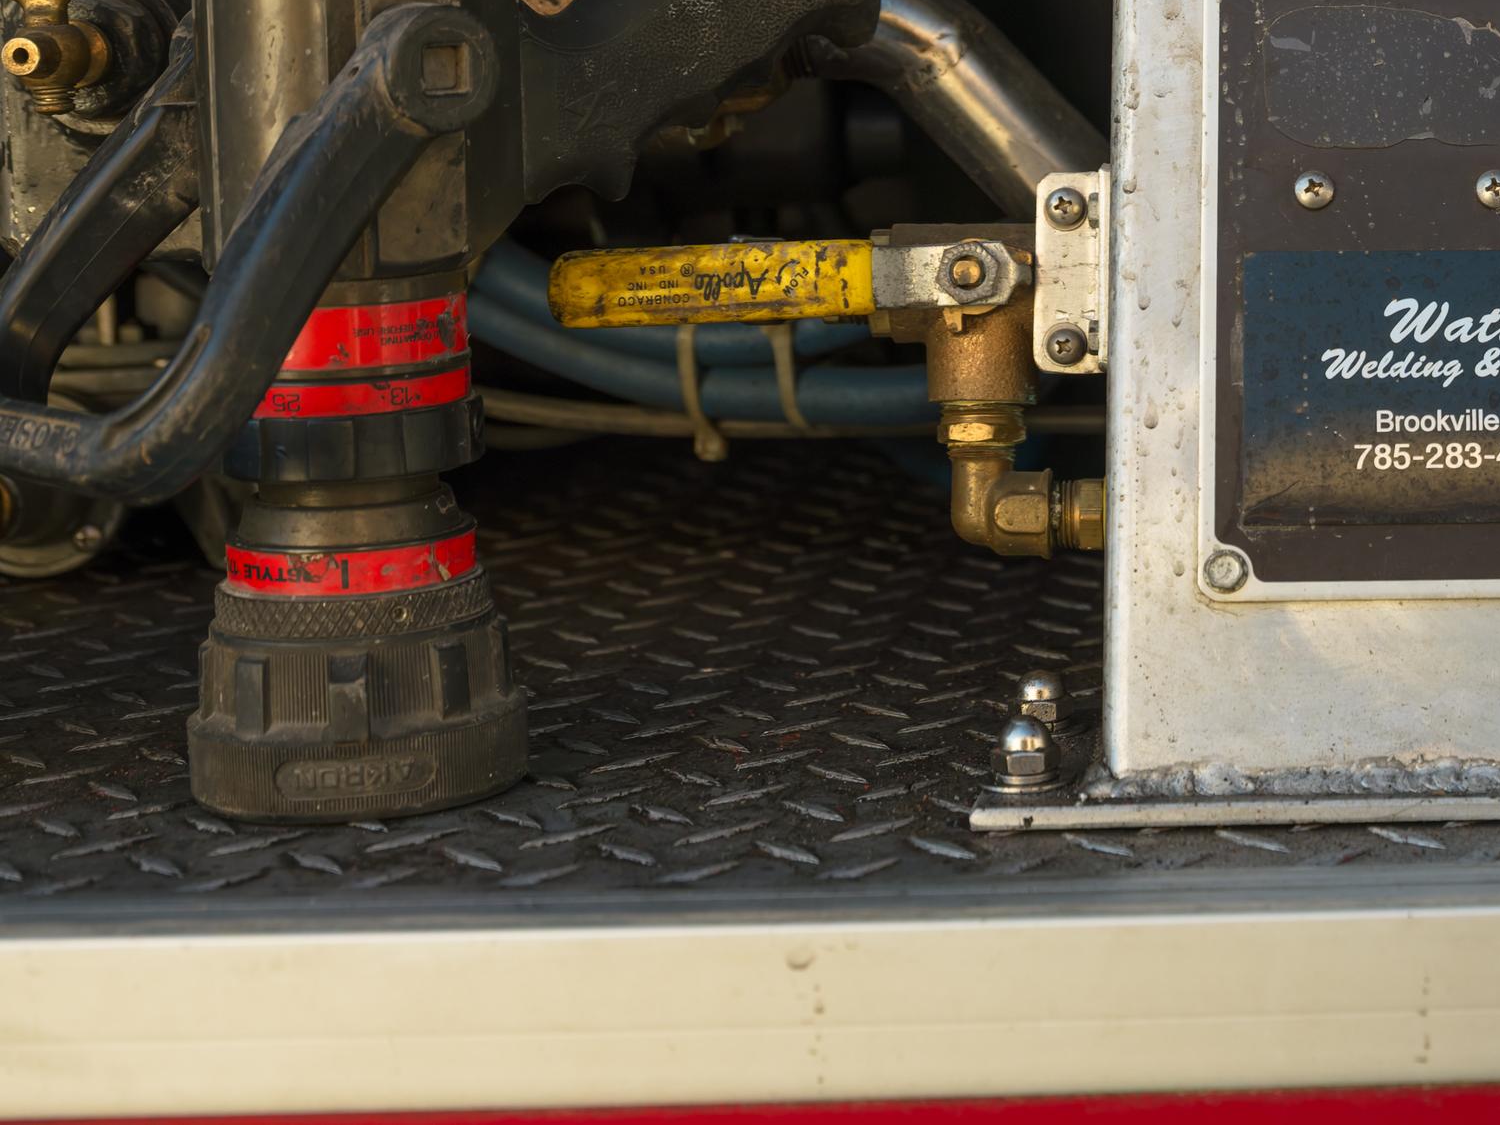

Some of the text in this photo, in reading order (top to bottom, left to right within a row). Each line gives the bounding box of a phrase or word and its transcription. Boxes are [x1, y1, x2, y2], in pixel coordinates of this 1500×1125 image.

[640, 266, 665, 275] USA
[628, 280, 678, 291] IND INC
[694, 261, 769, 301] Apollo
[618, 294, 690, 307] CONBRACO
[1321, 348, 1464, 388] Welding
[1475, 347, 1500, 376] &
[272, 393, 301, 412] 25
[296, 762, 414, 789] AKRON
